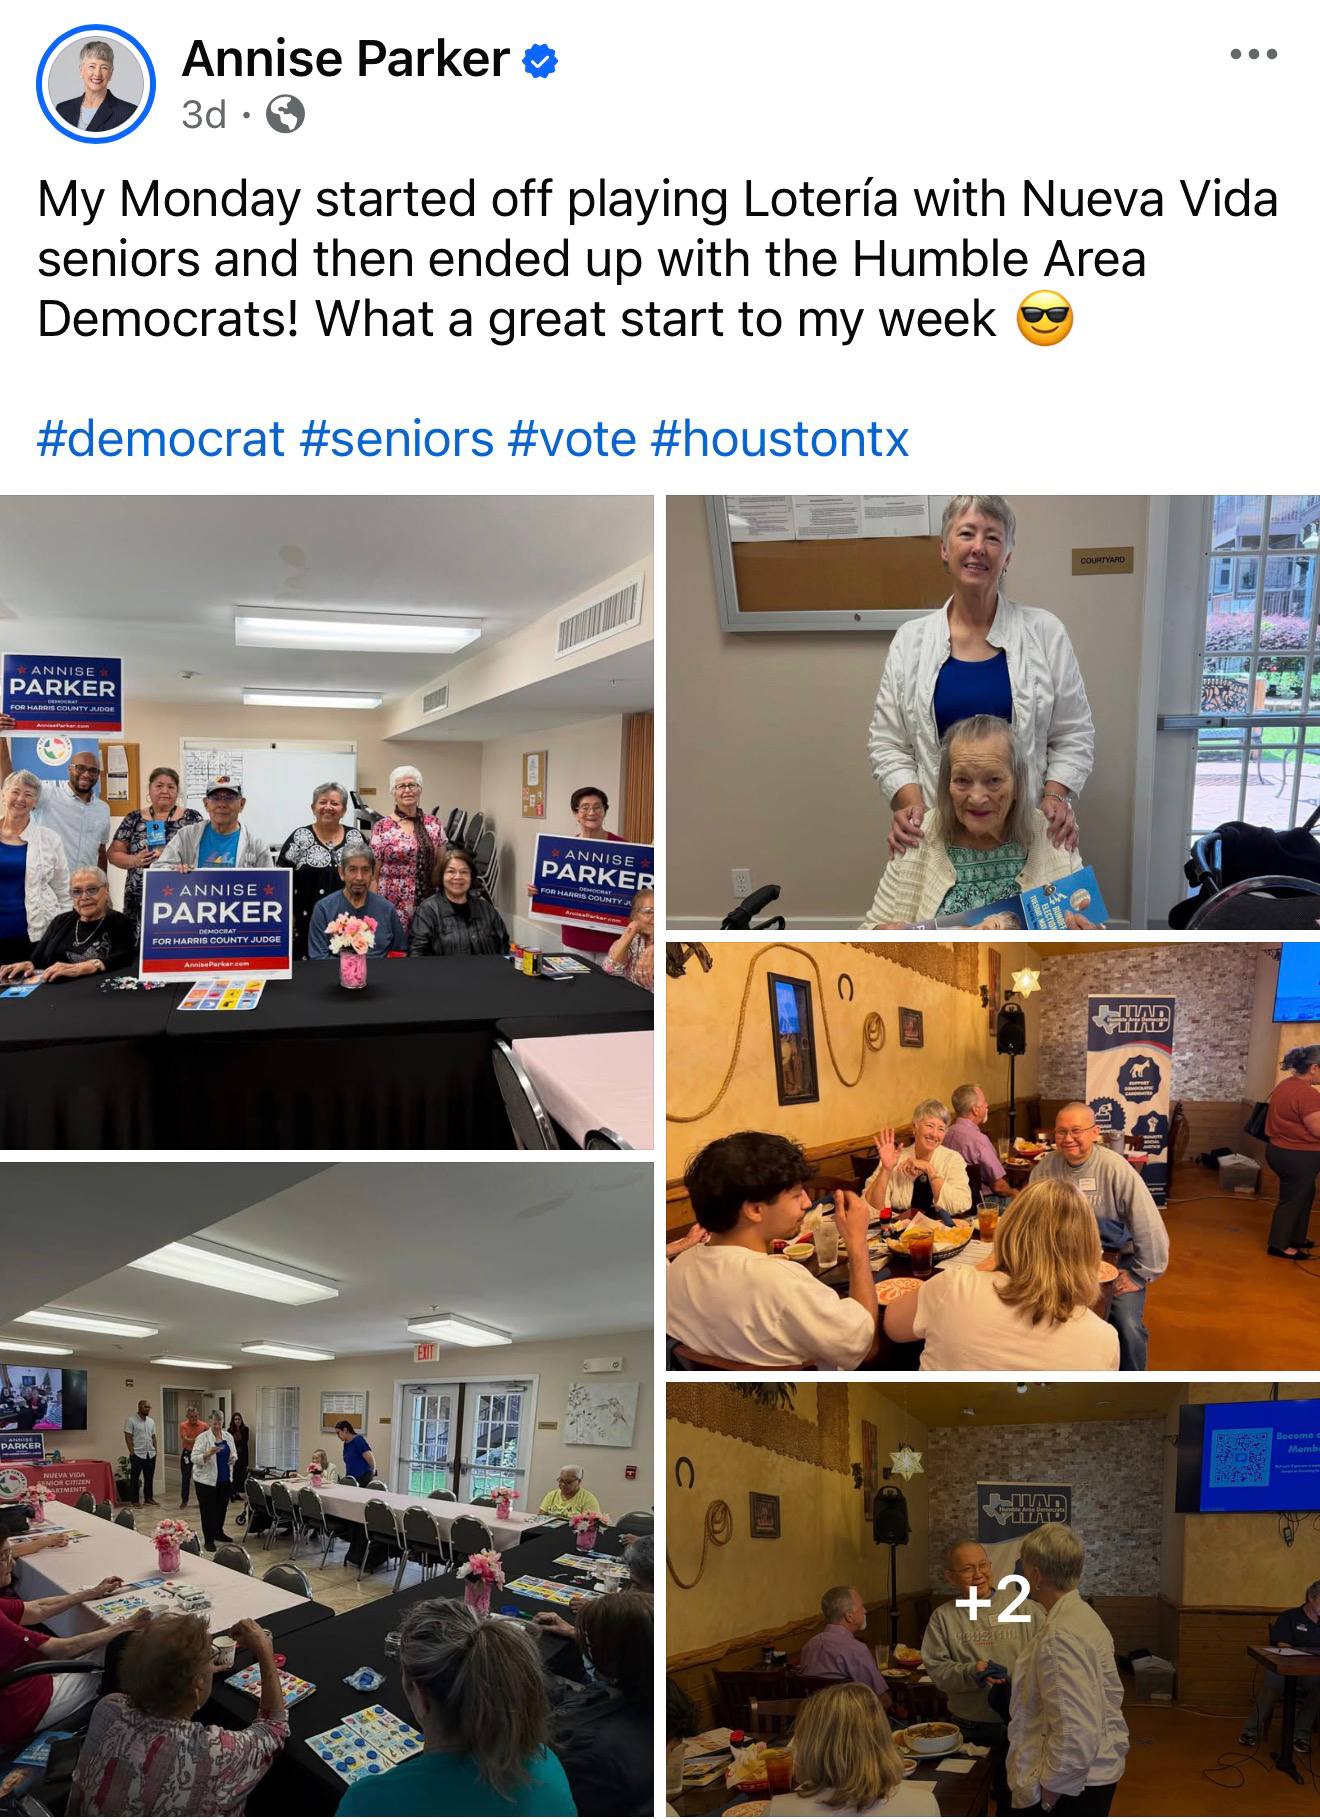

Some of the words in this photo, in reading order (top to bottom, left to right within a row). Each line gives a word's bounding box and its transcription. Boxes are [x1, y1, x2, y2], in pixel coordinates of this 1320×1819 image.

[1080, 556, 1126, 565] COURTYARD
[31, 665, 96, 677] ANNISE
[9, 678, 116, 698] PARKER
[565, 850, 635, 867] ANNISE
[541, 860, 654, 891] PARKER
[179, 883, 258, 897] ANNISE
[540, 887, 557, 896] FOR
[557, 889, 587, 900] HARRIS
[588, 894, 623, 904] COUNTY
[579, 886, 612, 896] DEMOCRAT
[152, 900, 283, 925] PARKER
[152, 938, 171, 946] FOR
[173, 937, 208, 945] HARRIS
[210, 936, 249, 944] COUNTY
[250, 935, 282, 943] JUDGE
[184, 961, 250, 969] AnniseParker.com
[1118, 1004, 1171, 1033] HAD
[417, 1343, 434, 1361] EXIT
[1, 1442, 42, 1450] PARKER
[1011, 1493, 1068, 1524] HAD
